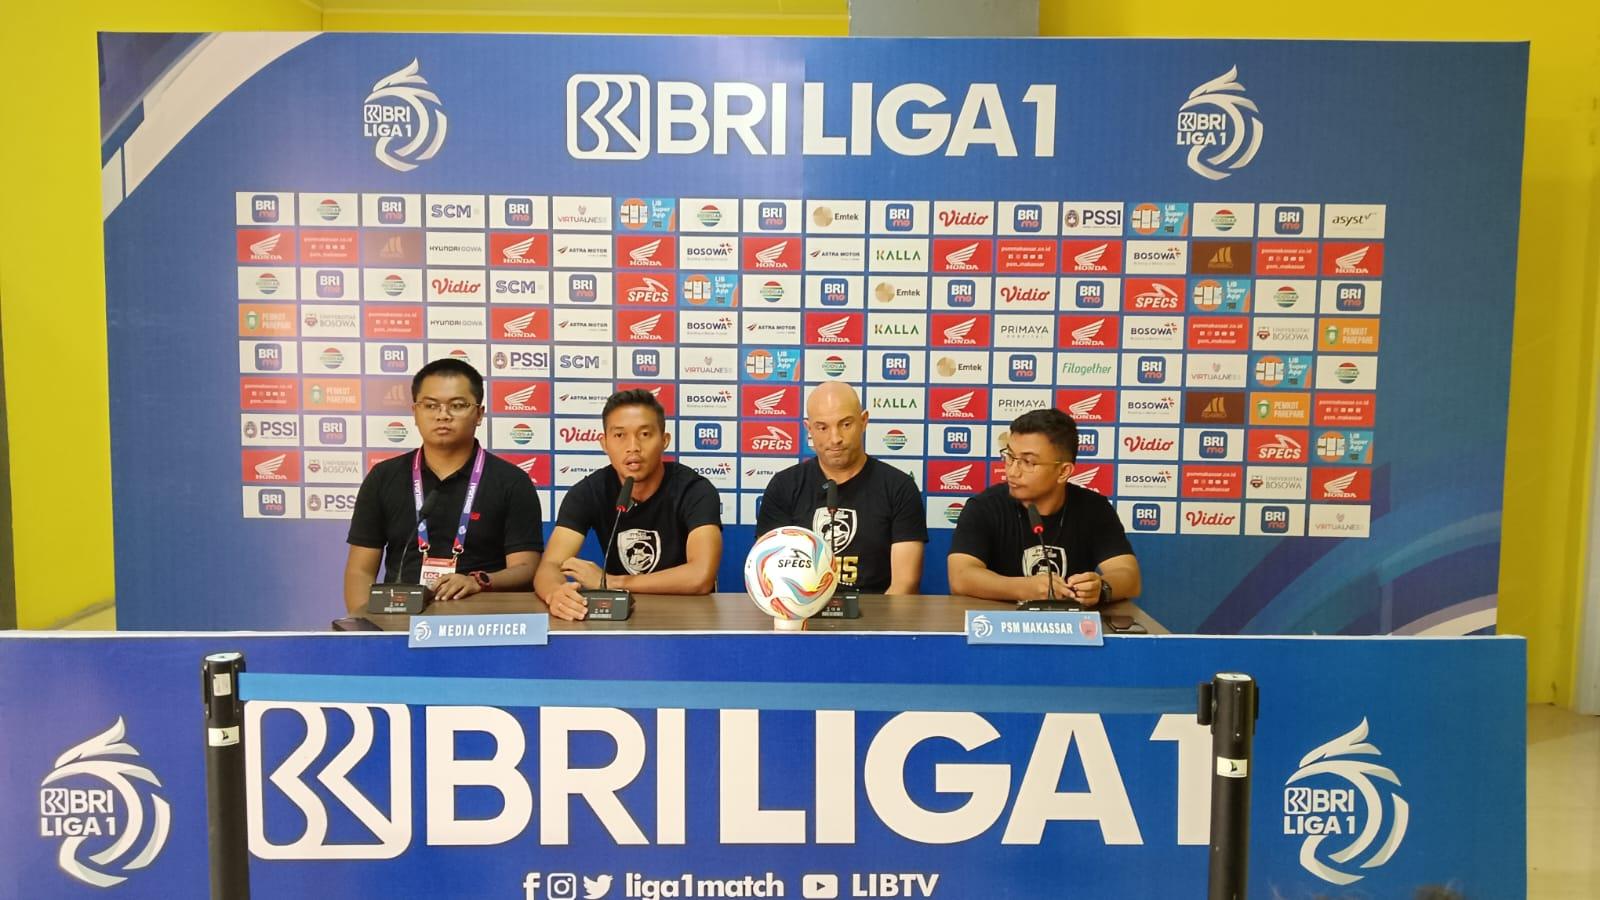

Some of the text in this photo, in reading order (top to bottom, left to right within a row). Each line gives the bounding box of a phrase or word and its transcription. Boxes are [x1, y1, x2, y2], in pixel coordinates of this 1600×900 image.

[383, 106, 411, 123] BRI
[657, 82, 786, 155] BRI
[1198, 114, 1226, 130] BRI
[364, 124, 412, 137] LIGA 1
[1177, 132, 1226, 145] LIGA 1
[256, 200, 274, 210] BRI
[382, 201, 401, 212] BRI
[509, 203, 528, 214] BRI
[431, 204, 471, 218] SCM
[763, 207, 782, 218] BRI
[890, 208, 909, 219] BRI
[1018, 209, 1038, 220] BRI
[1279, 211, 1299, 222] BRI
[939, 210, 988, 226] Vidio
[1082, 209, 1120, 225] PSSI
[1332, 215, 1363, 227] asyst
[876, 250, 920, 260] KALLA
[432, 278, 480, 294] Vidio
[495, 280, 535, 293] SCM
[573, 279, 592, 290] BRI
[825, 283, 844, 294] BRI
[952, 284, 971, 295] BRI
[1000, 286, 1050, 302] Vidio
[1080, 285, 1100, 296] BRI
[1341, 288, 1361, 299] BRI
[627, 291, 668, 302] SPECS
[1135, 297, 1177, 308] SPECS
[875, 324, 918, 334] KALLA
[1001, 325, 1048, 333] PRIMAYA
[1131, 327, 1172, 335] BOSOWA
[1272, 332, 1309, 340] BOSOWA
[259, 348, 277, 359] BRI
[385, 350, 403, 360] BRI
[510, 352, 547, 367] PSSI
[559, 355, 599, 368] SCM
[636, 354, 655, 365] BRI
[886, 357, 905, 368] BRI
[1013, 359, 1032, 370] BRI
[957, 363, 981, 371] Emtek
[1062, 362, 1111, 374] Filogether
[1142, 360, 1161, 371] BRI
[873, 398, 916, 408] KALLA
[998, 399, 1046, 407] PRIMAYA
[260, 421, 296, 436] PSSI
[699, 427, 717, 438] BRI
[948, 431, 967, 442] BRI
[1204, 436, 1223, 446] BRI
[751, 439, 792, 450] SPECS
[1124, 436, 1173, 452] Vidio
[1259, 448, 1301, 459] SPECS
[694, 467, 726, 475] OSOWA
[1265, 481, 1301, 489] BOSOWA
[324, 494, 357, 510] PSS
[1137, 508, 1156, 519] BRI
[1185, 510, 1235, 526] Vidio
[1265, 511, 1285, 521] BRI
[777, 559, 812, 569] SPECS
[439, 623, 526, 637] MEDIA OFFICER
[1001, 621, 1073, 634] PSM MAKASSAR
[426, 705, 686, 845] BRI
[71, 789, 113, 813] BRI
[1312, 789, 1354, 812] BRI
[41, 816, 116, 836] LIGA 1
[1284, 816, 1355, 835] LIGA 1
[625, 872, 784, 900] liga1match
[852, 873, 939, 897] LIBTV
